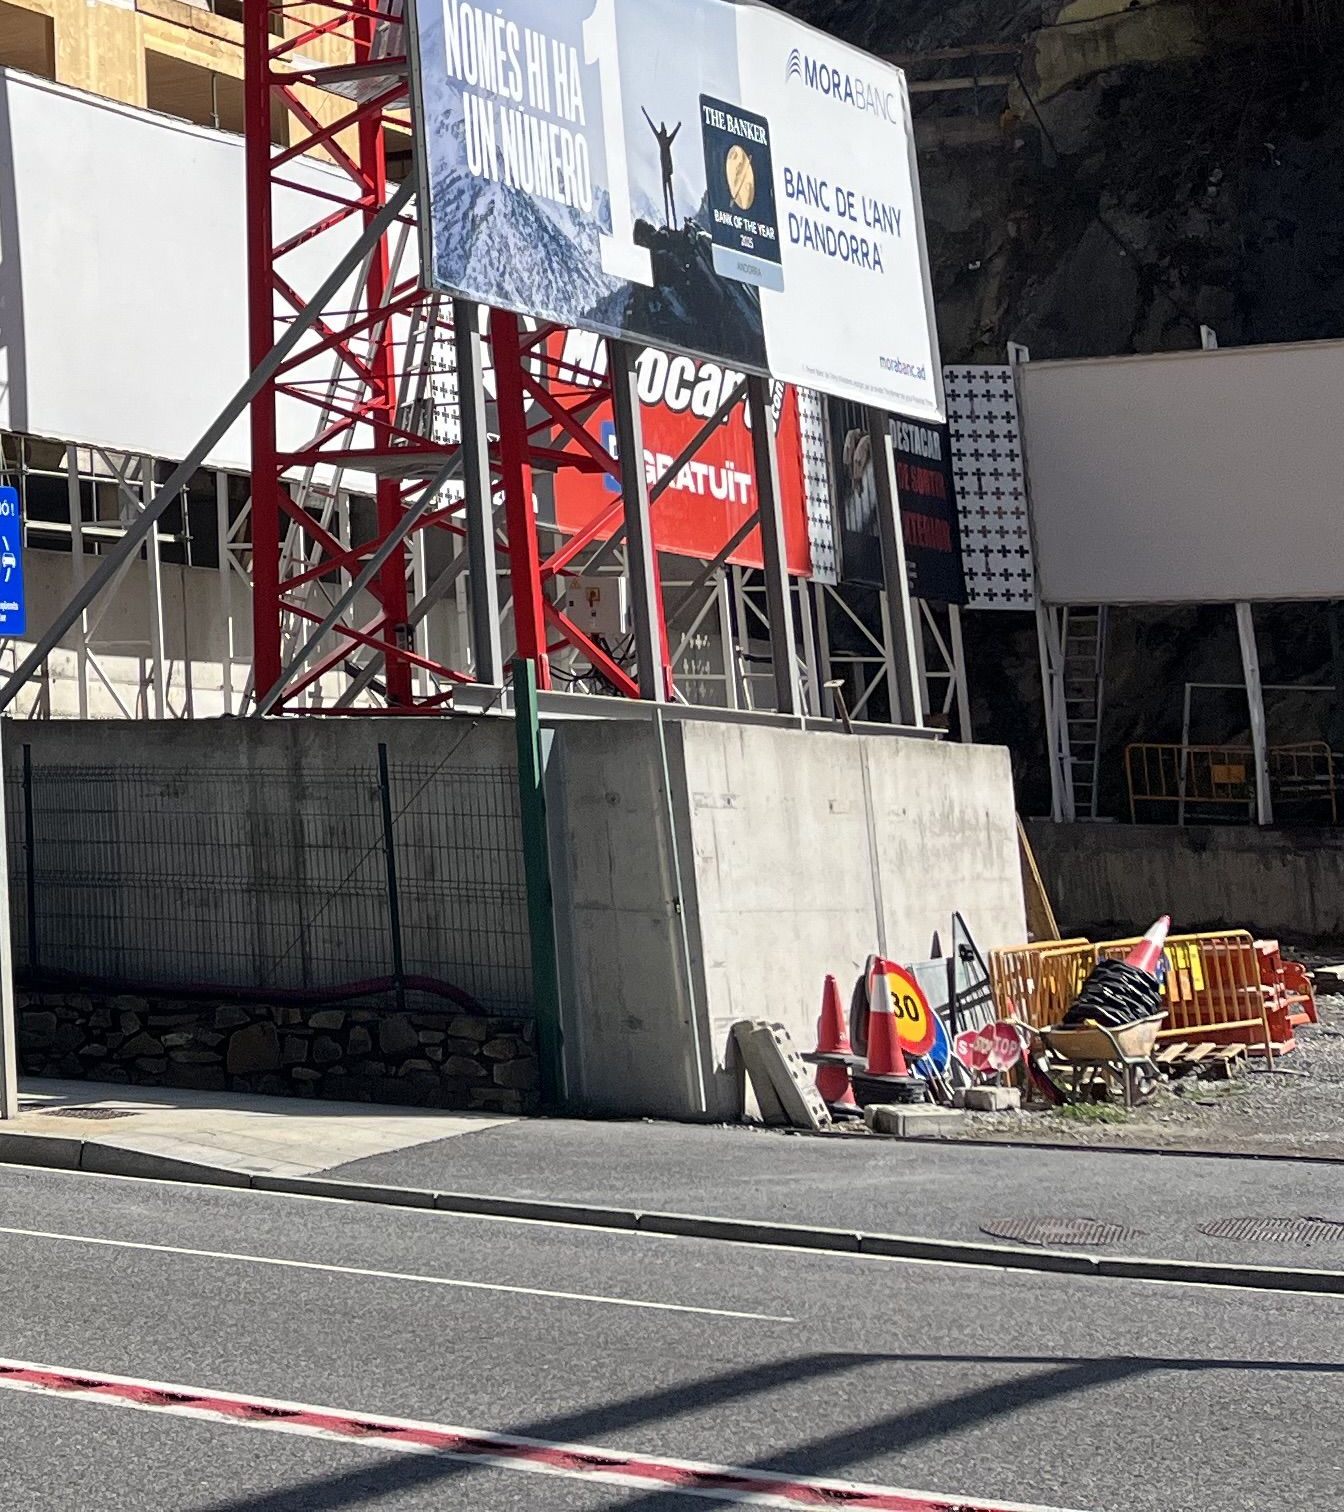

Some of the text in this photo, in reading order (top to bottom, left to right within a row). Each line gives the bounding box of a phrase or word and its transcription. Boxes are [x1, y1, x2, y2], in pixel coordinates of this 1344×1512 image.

[524, 28, 551, 113] HI
[552, 40, 586, 126] HA
[804, 55, 896, 124] MORABANC
[463, 91, 592, 213] UN NÚMERO
[703, 105, 767, 146] THE BANKER
[733, 215, 743, 229] OF
[743, 218, 757, 234] THE
[757, 223, 775, 240] YEAR
[784, 167, 901, 238] BANC DE L'ANY
[788, 212, 884, 274] D'ANDORRA
[890, 991, 920, 1022] 30
